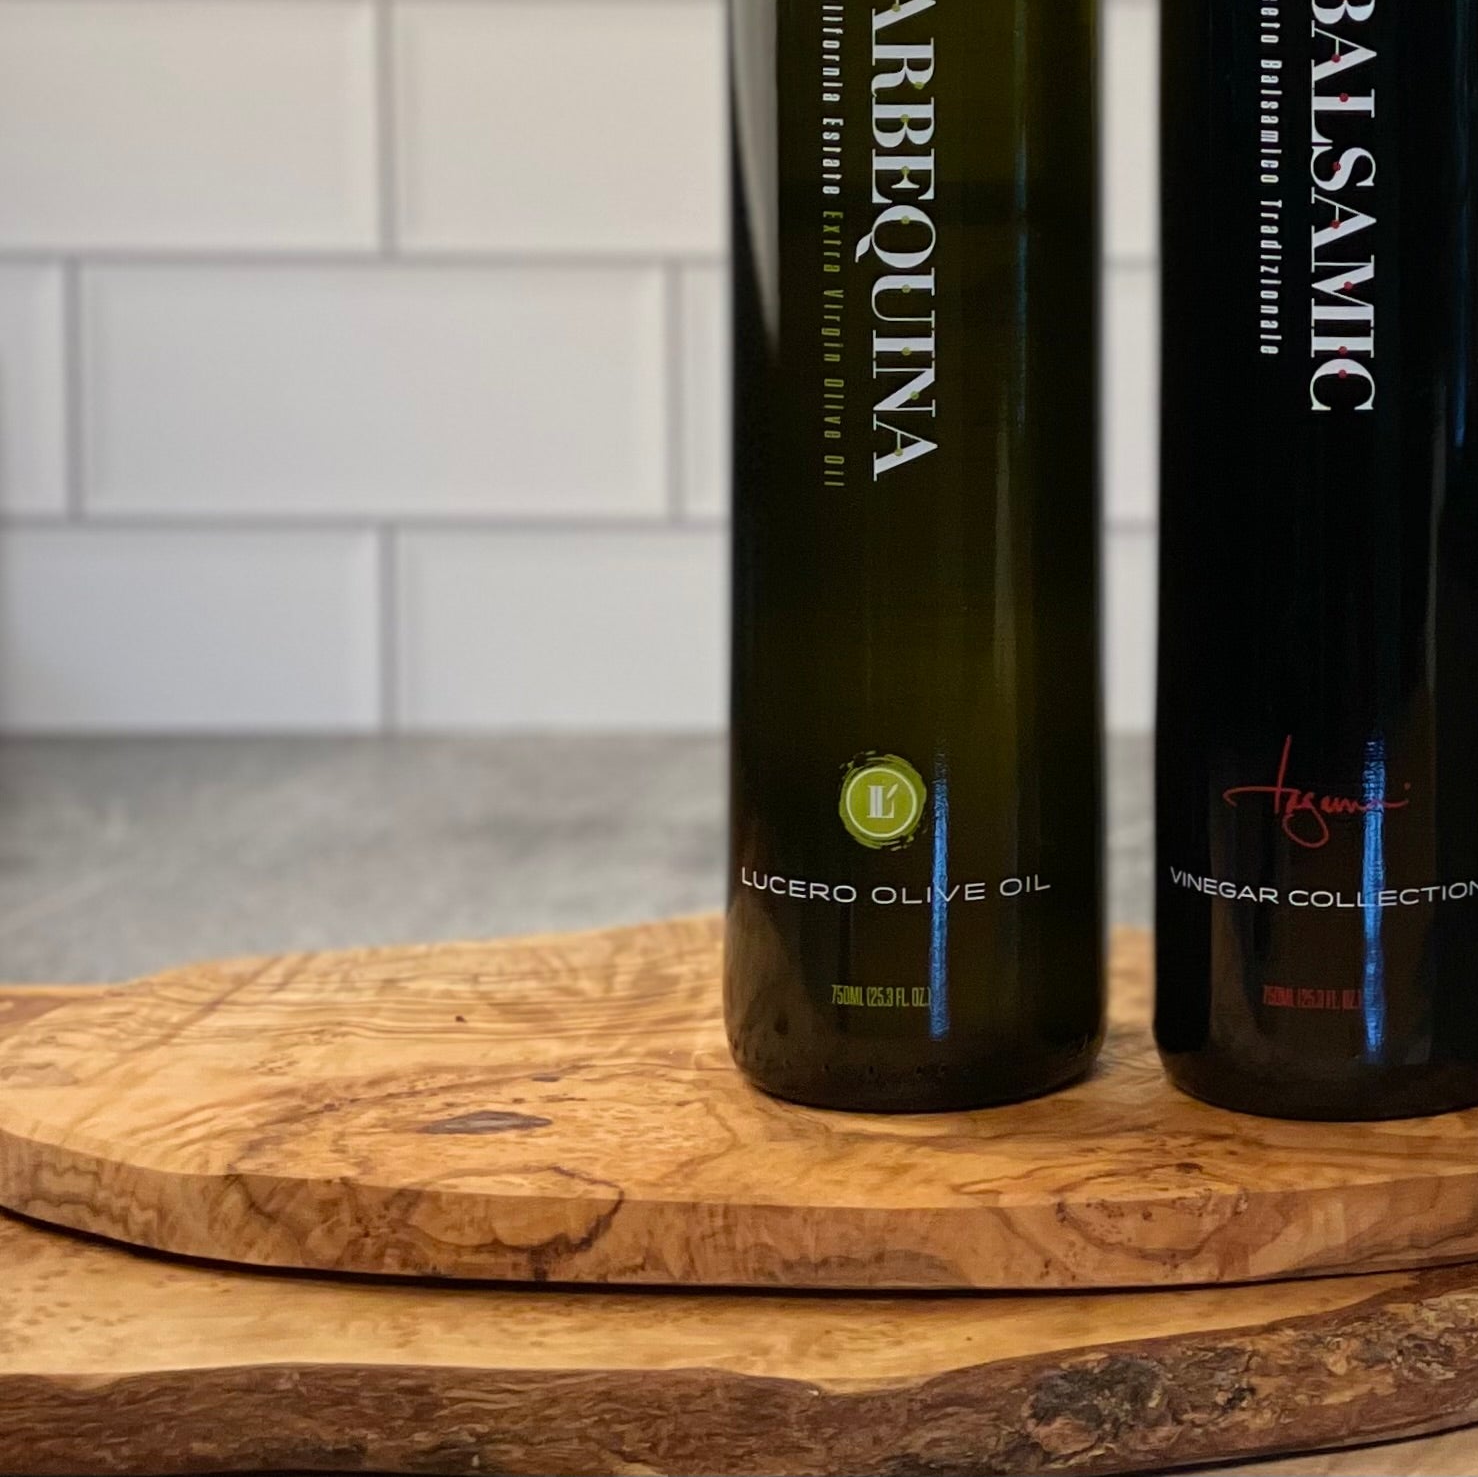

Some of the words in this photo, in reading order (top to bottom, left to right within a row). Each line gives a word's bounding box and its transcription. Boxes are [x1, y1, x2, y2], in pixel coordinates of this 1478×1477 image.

[1260, 59, 1283, 184] Balsamico
[822, 117, 844, 195] Estate
[822, 210, 844, 273] Extra
[1259, 199, 1283, 355] Tradizionale
[821, 289, 844, 362] Virgin
[823, 378, 845, 439] Olive
[823, 455, 845, 487] Oil
[741, 866, 857, 903] LUCERO
[871, 882, 986, 904] OLIVE
[999, 874, 1051, 897] OIL
[1170, 866, 1279, 904] VINEGAR
[831, 984, 864, 1006] 750ML
